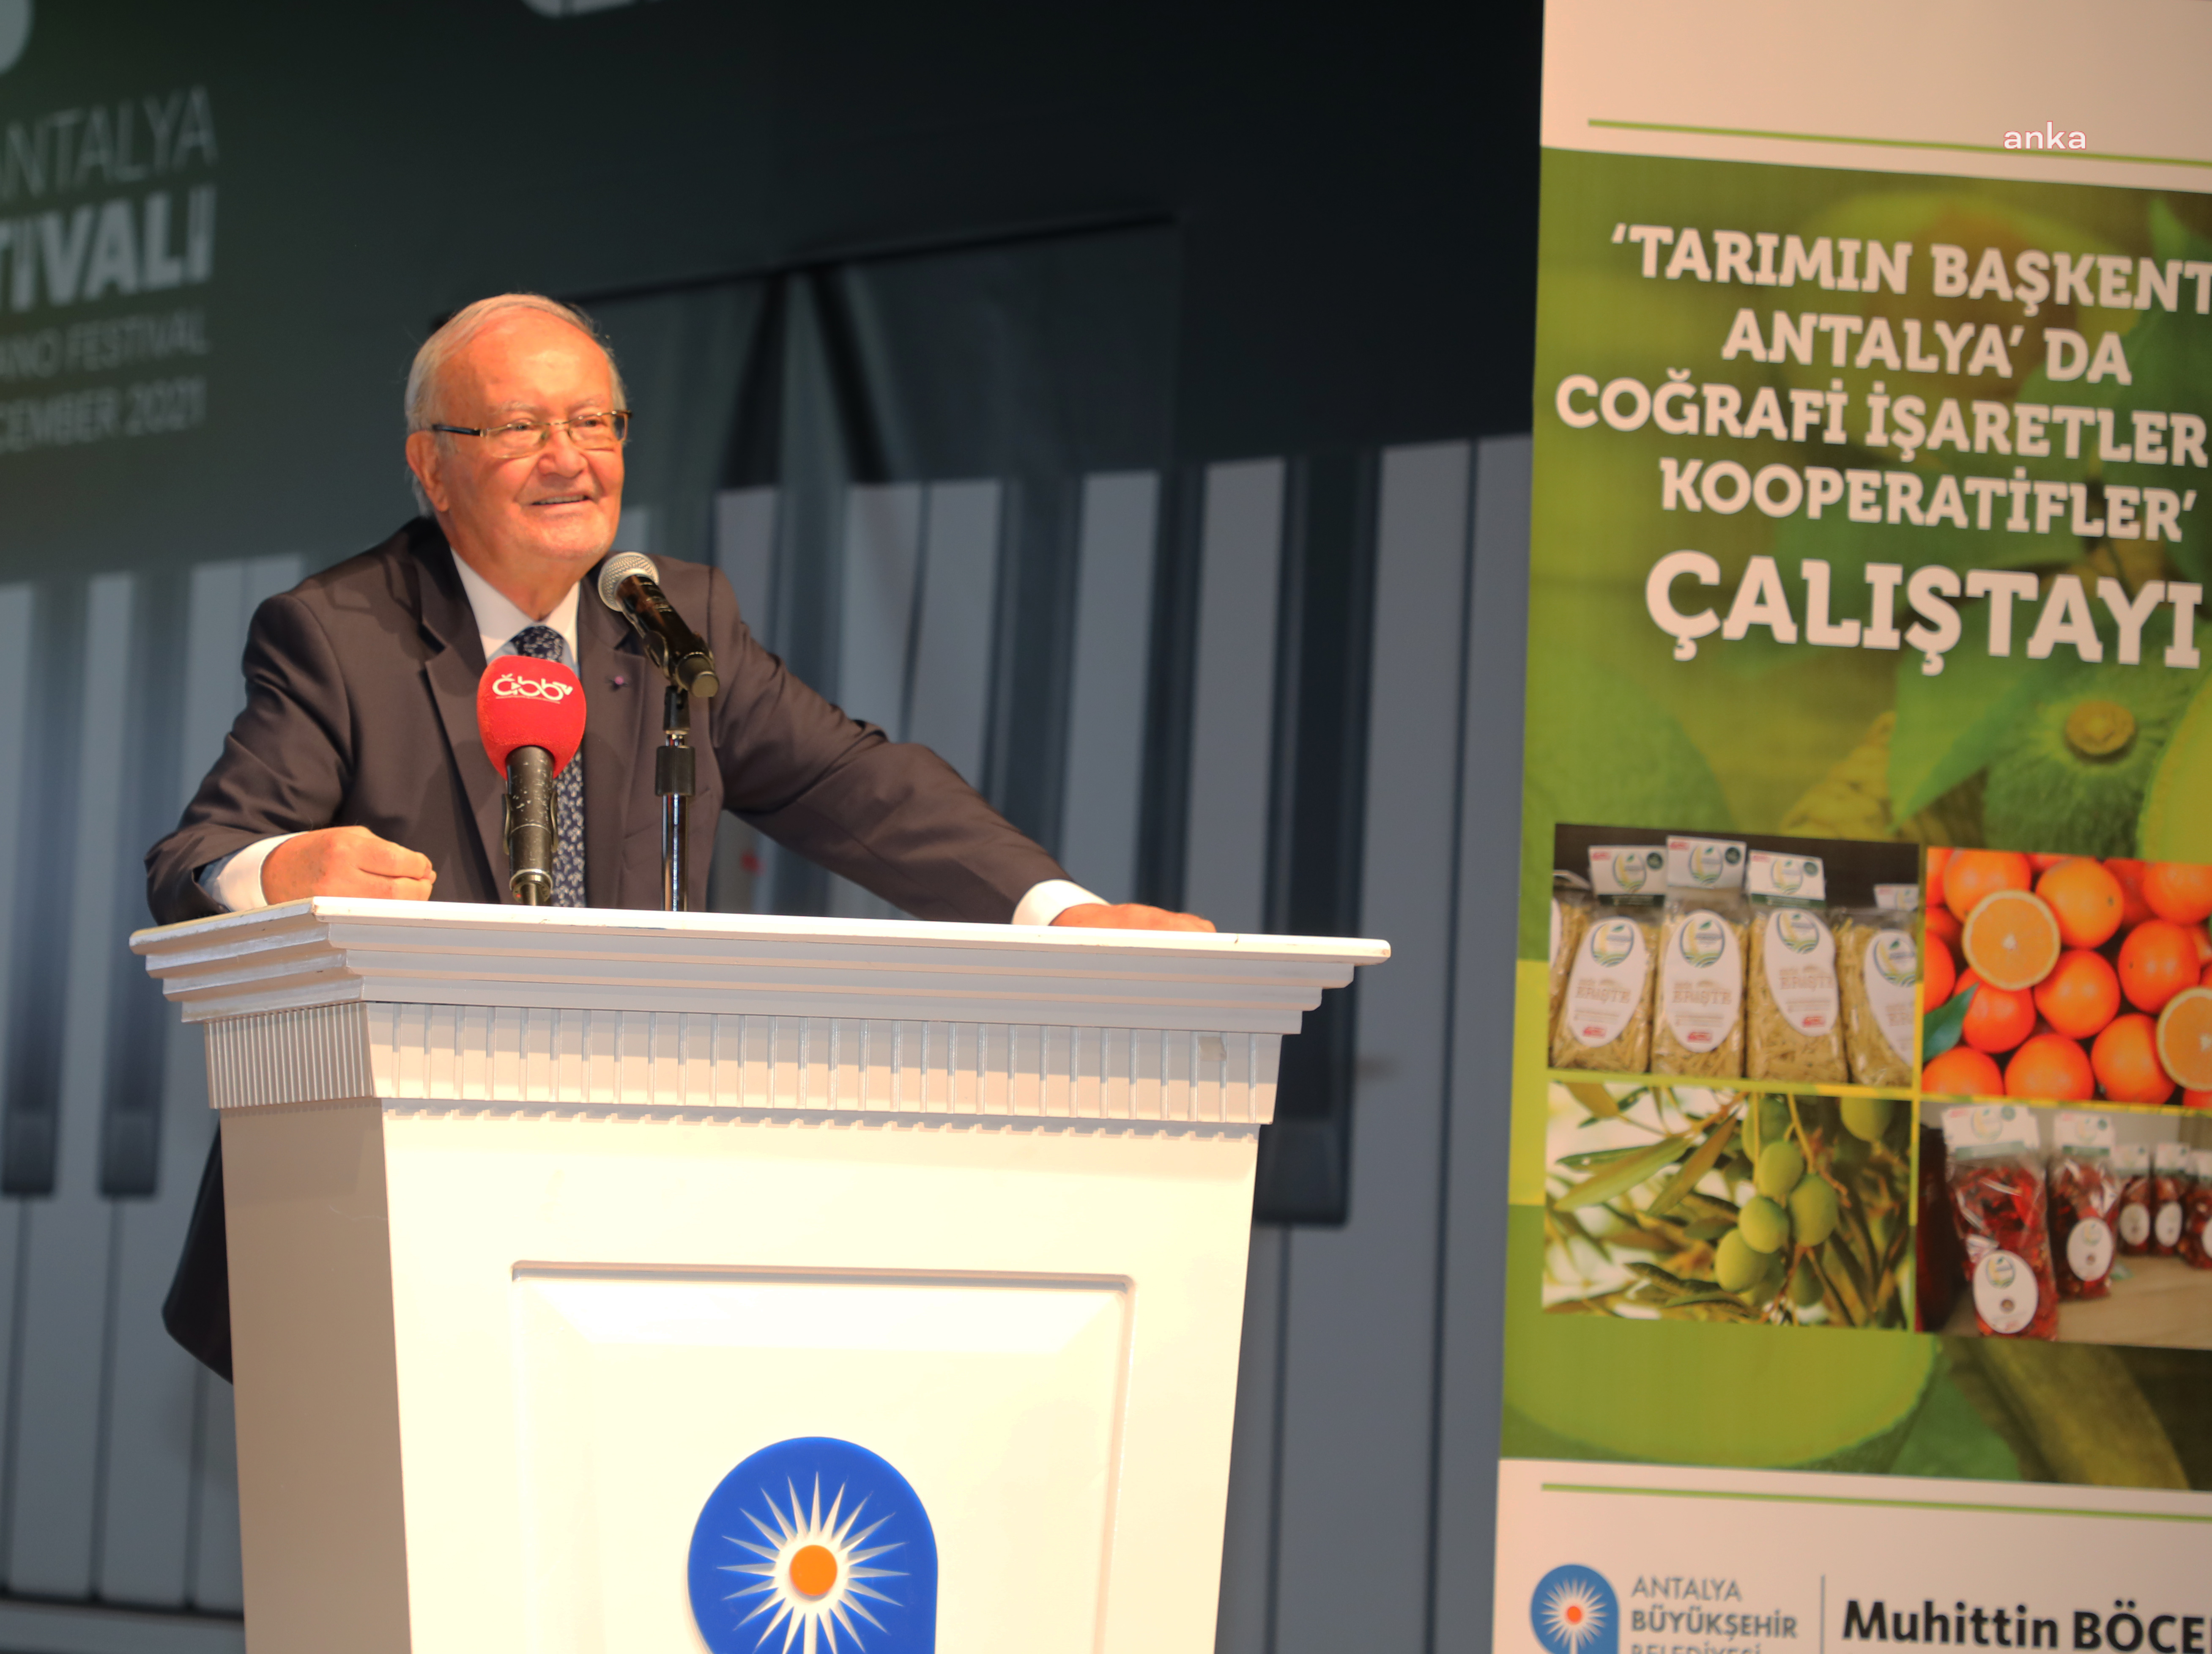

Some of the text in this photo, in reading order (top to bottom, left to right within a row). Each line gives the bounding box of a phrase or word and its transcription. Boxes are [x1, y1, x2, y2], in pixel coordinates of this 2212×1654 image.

[1612, 222, 2212, 316] 'TARIMIN BAŞKENT
[1722, 308, 2132, 386] ANTALYA' DA
[1555, 367, 2208, 468] COĞRAFİ İŞARETLER
[1659, 457, 2196, 543] KOOPERATİFLER'
[1645, 549, 2203, 677] ÇALIŞTAYI
[1631, 1576, 1742, 1602] ANTALYA
[1632, 1605, 1798, 1641] BÜYÜKŞEHİR
[1843, 1599, 2212, 1654] Muhittin BÖCE
